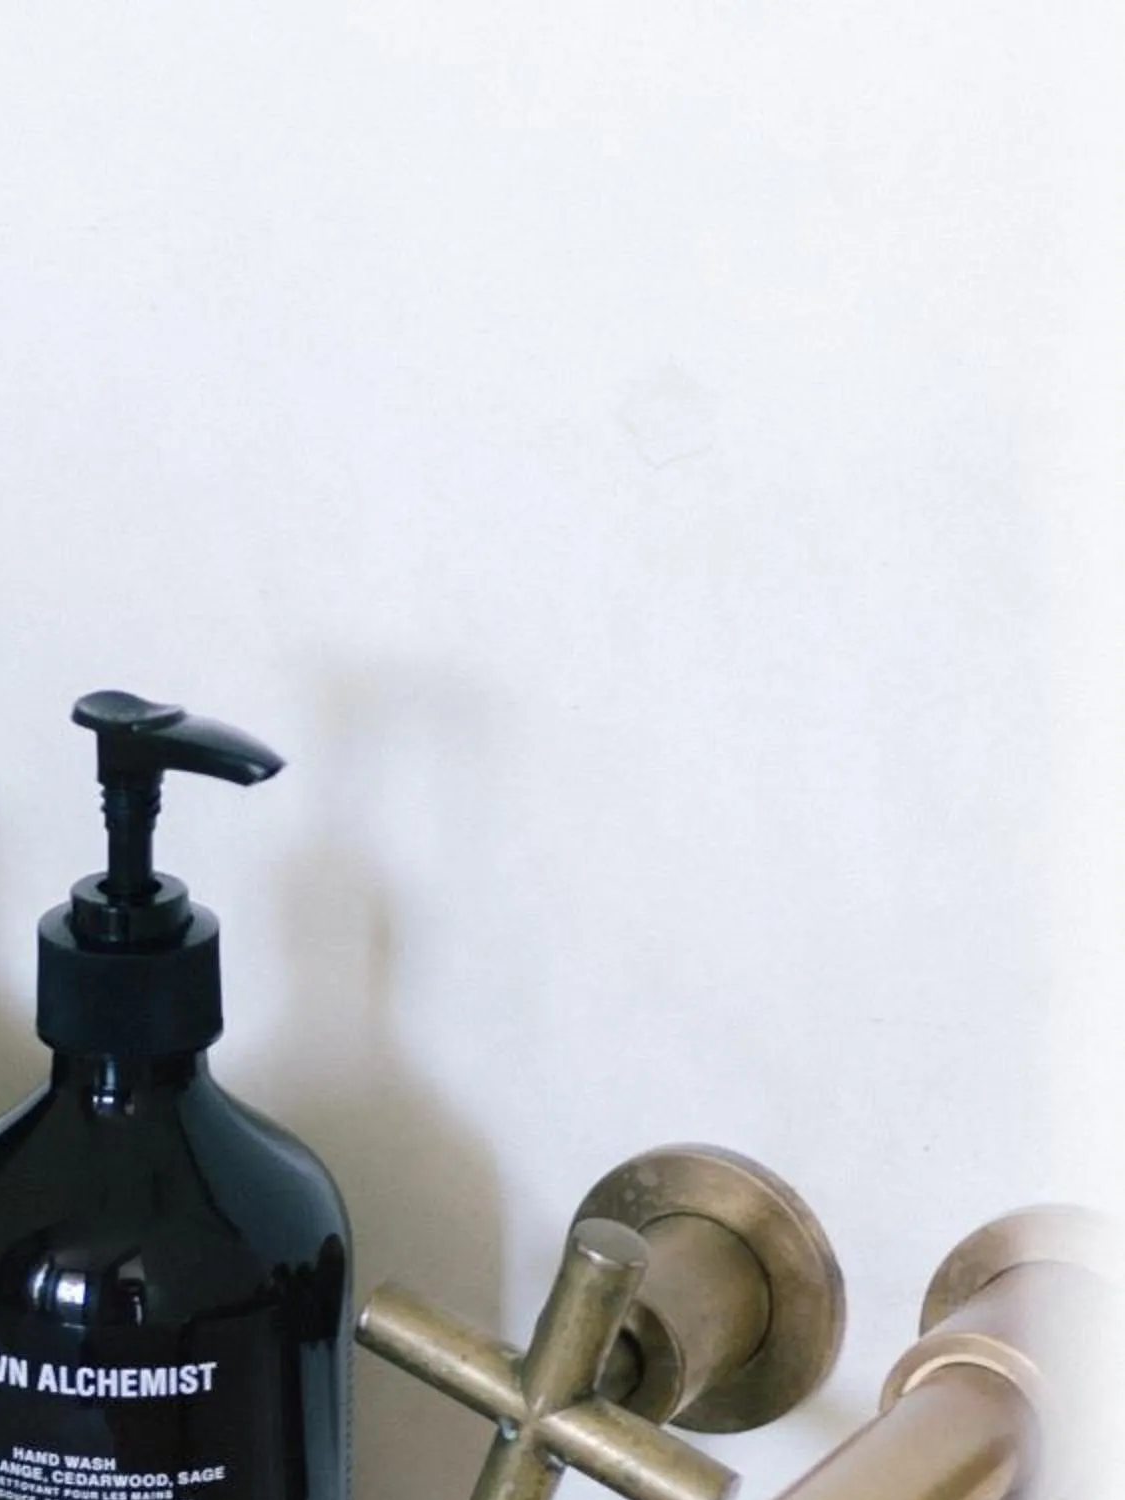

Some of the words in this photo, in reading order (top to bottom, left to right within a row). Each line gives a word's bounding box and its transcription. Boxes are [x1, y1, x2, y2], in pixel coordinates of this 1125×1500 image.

[37, 1362, 218, 1398] ALCHEMIST
[12, 1446, 60, 1468] HAND
[63, 1454, 117, 1472] WASH
[51, 1469, 174, 1489] CEDARWOOD,
[177, 1465, 226, 1486] SAGE
